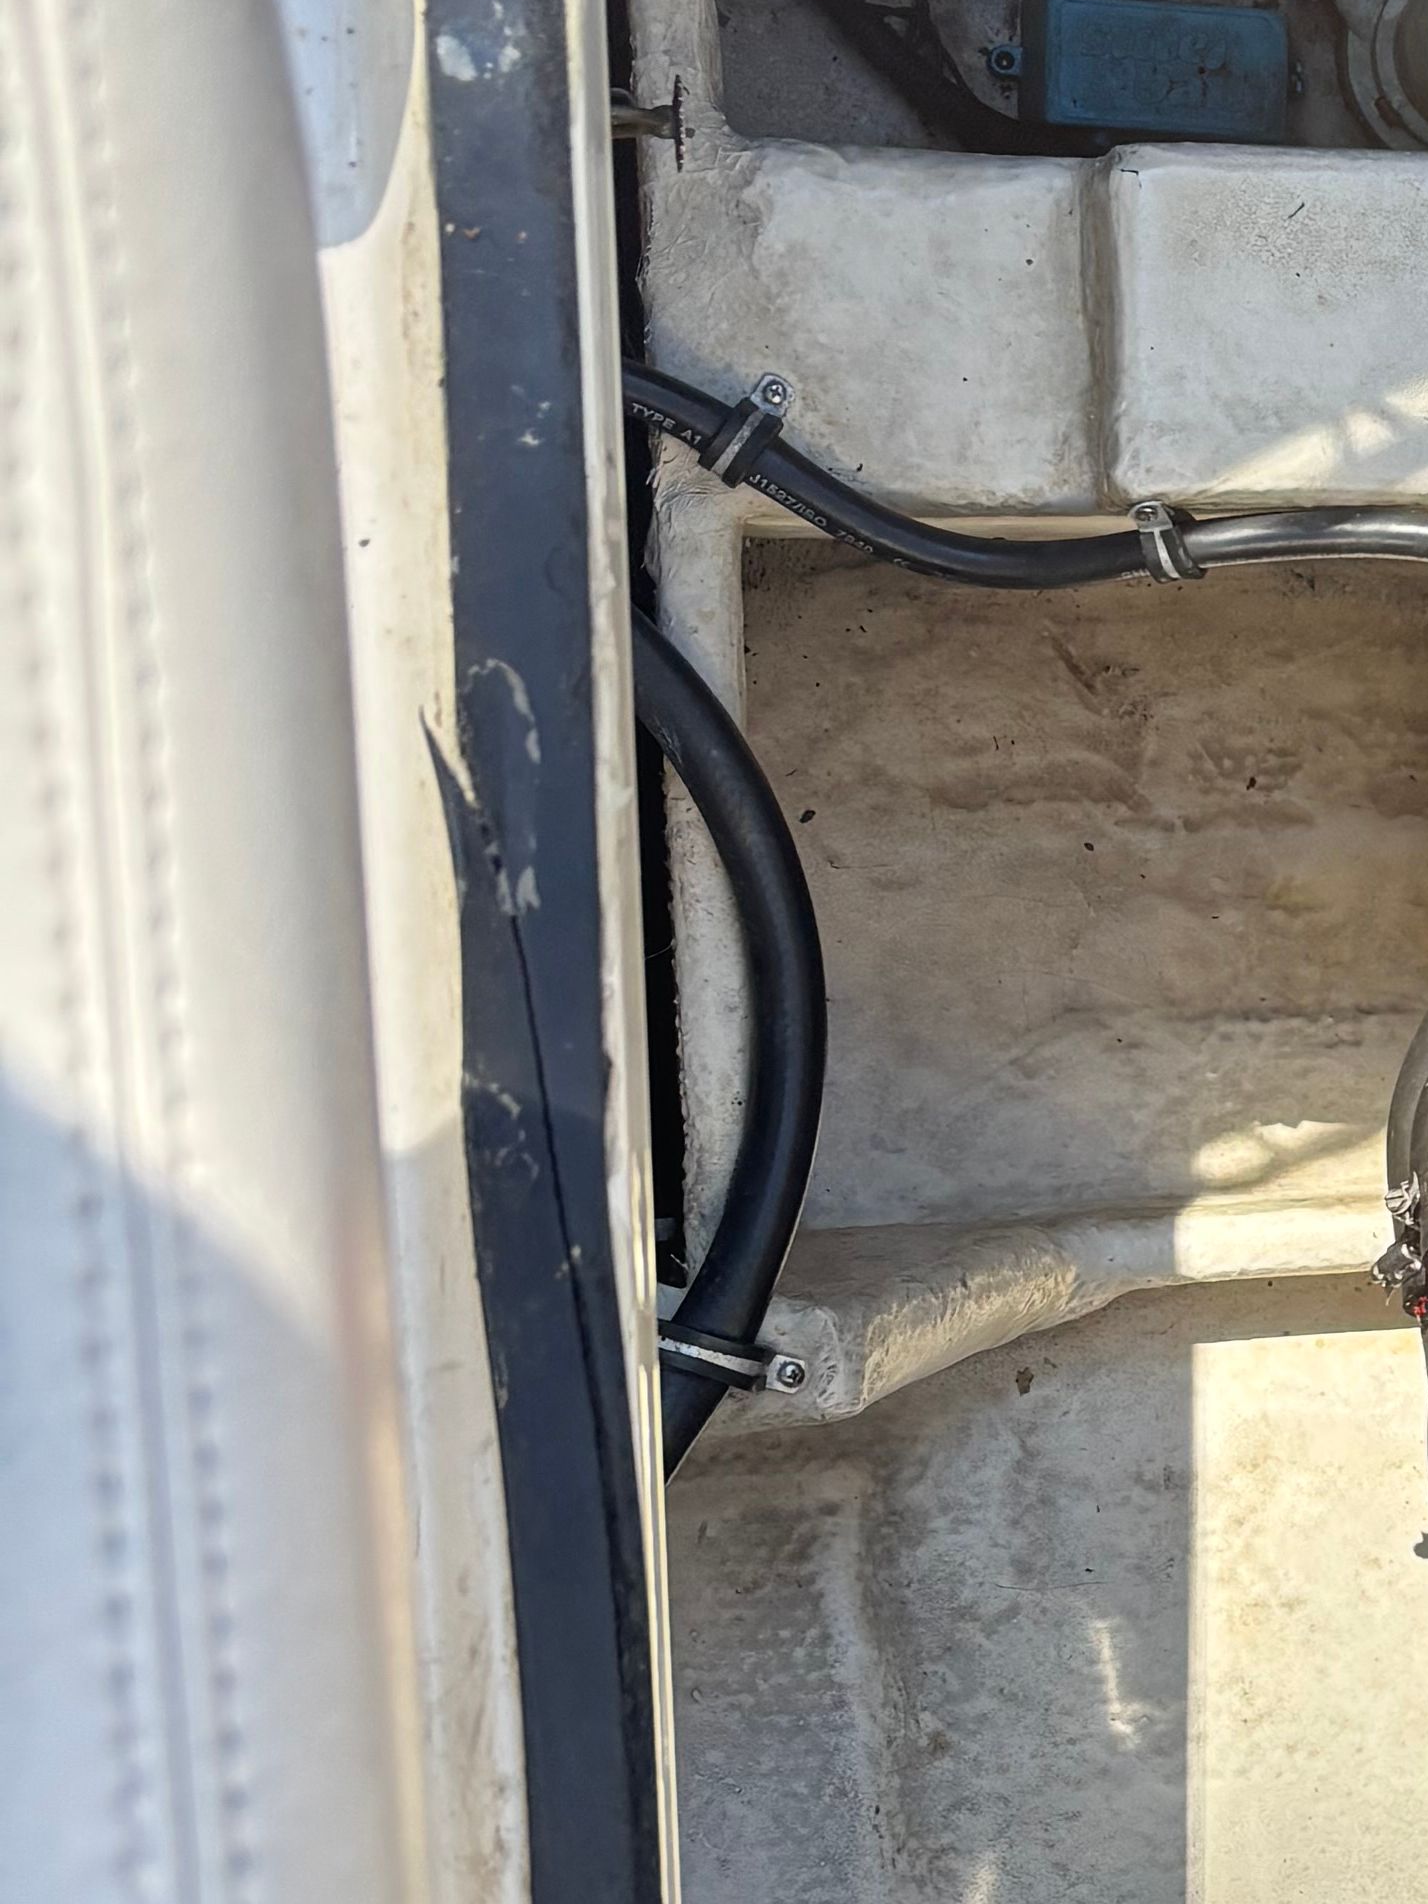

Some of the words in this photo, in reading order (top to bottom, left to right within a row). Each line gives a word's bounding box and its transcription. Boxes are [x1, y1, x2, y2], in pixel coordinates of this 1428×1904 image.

[632, 402, 677, 431] TYPE
[679, 428, 703, 446] A1
[747, 470, 829, 529] J1527/ISO
